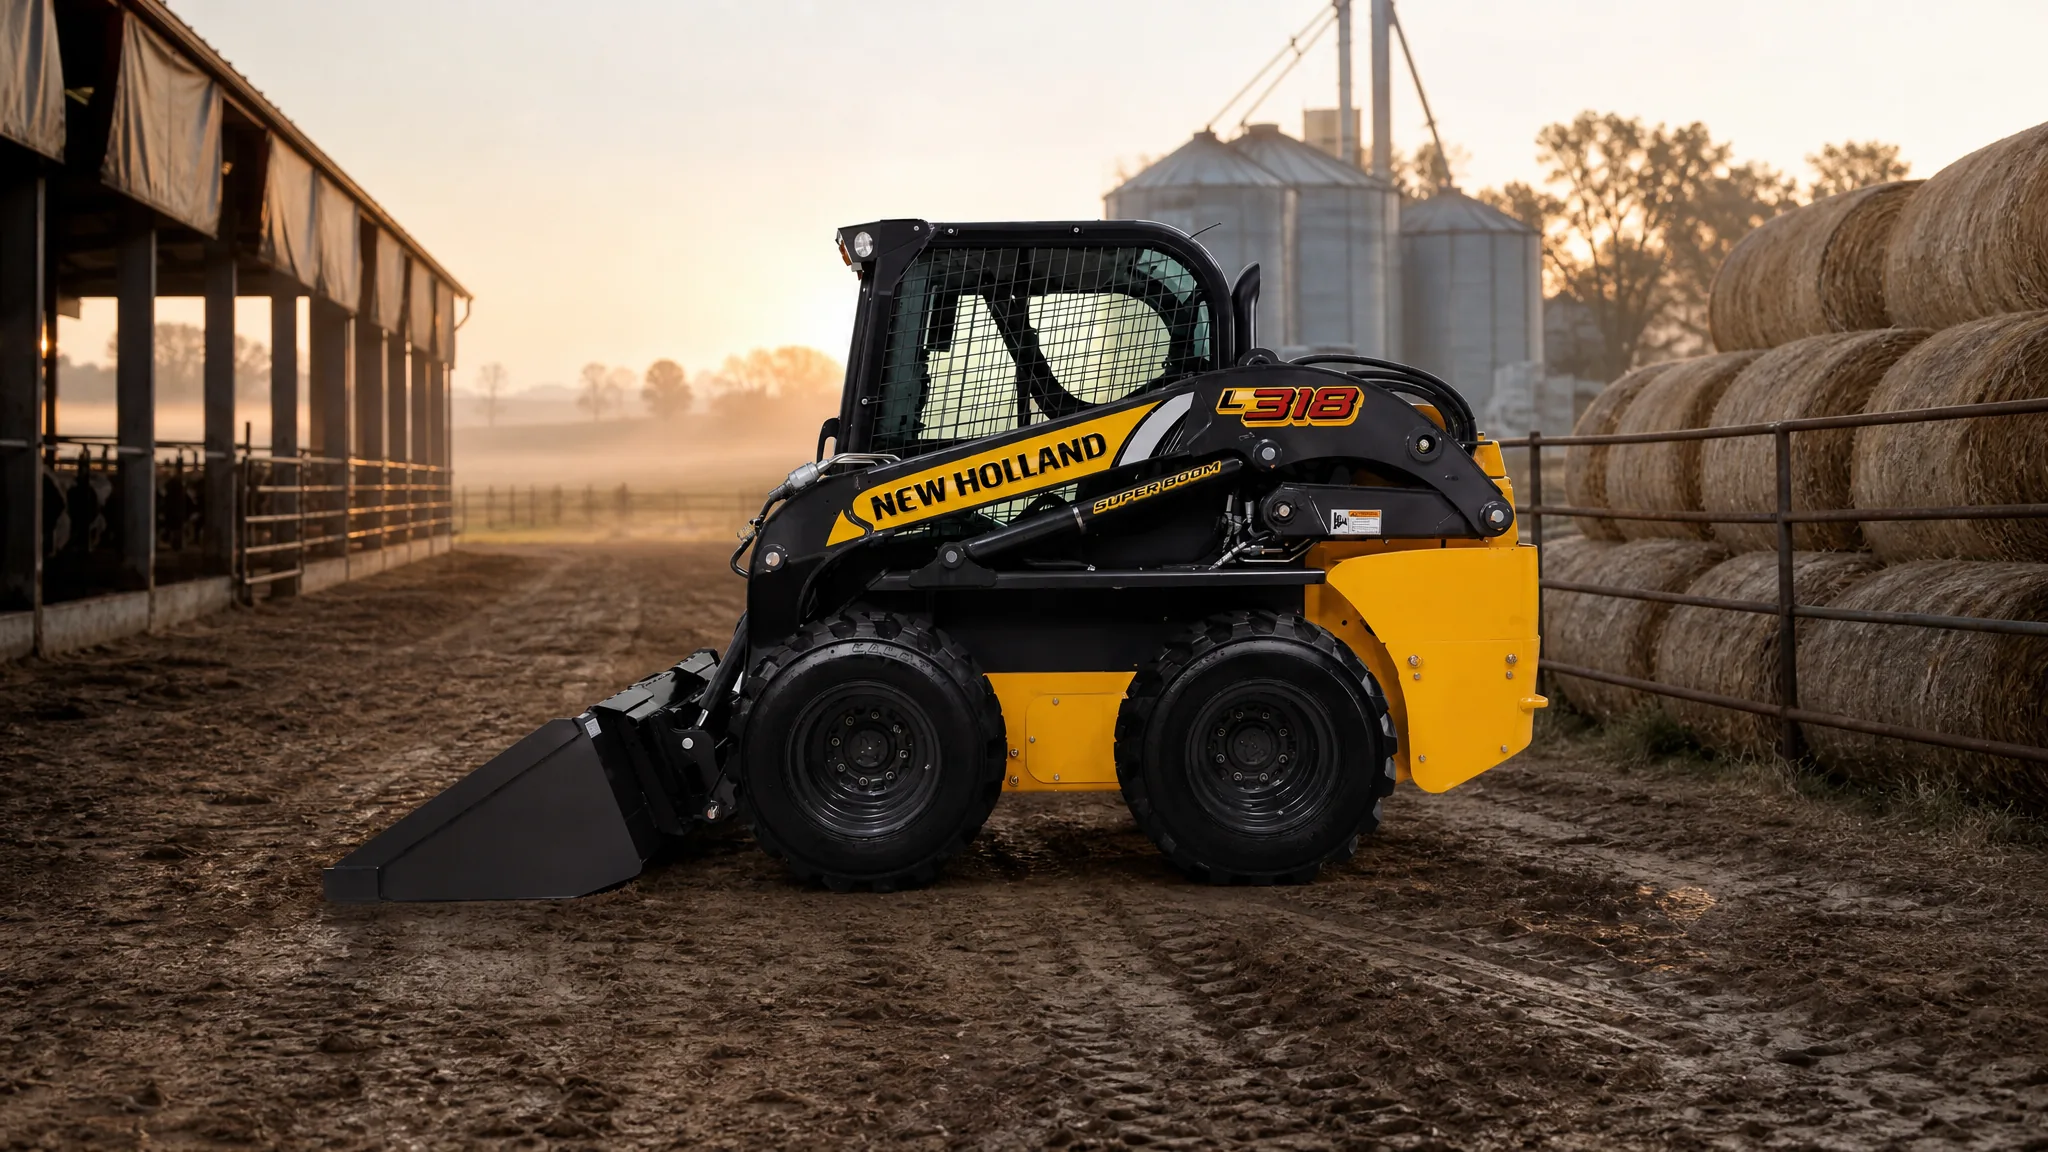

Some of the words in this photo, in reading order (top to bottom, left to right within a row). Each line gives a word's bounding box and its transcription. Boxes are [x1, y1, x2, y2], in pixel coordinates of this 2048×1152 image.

[1217, 387, 1362, 424] L318
[870, 477, 946, 521] NEW
[953, 432, 1107, 497] HOLLAND
[1093, 481, 1160, 514] SUPER
[1162, 460, 1221, 491] BOOM
